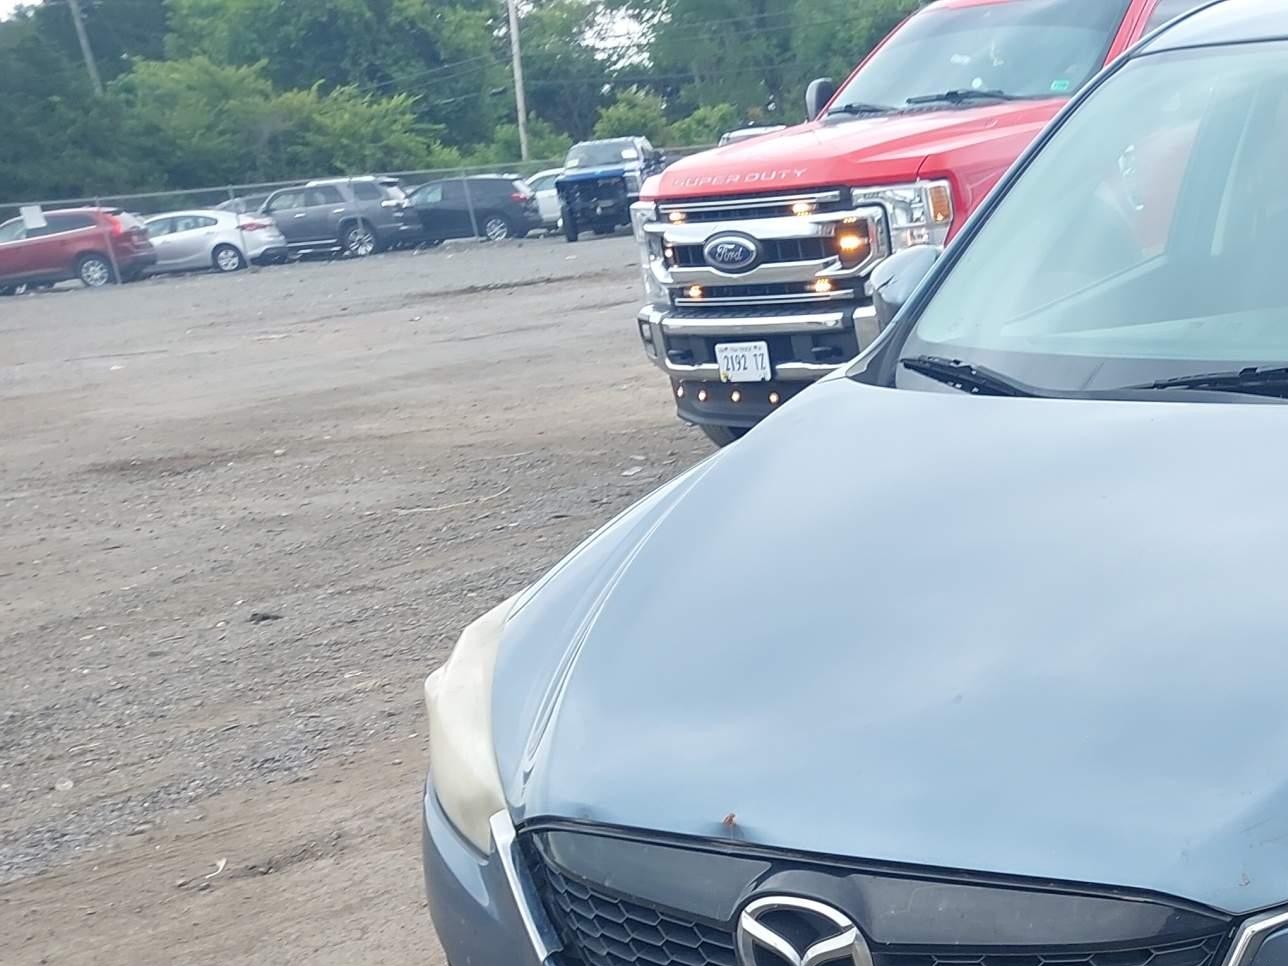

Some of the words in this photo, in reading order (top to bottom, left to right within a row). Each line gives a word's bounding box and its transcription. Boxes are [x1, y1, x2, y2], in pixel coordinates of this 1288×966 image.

[673, 175, 741, 188] SUPER
[744, 168, 808, 182] DUTY
[716, 243, 744, 260] Ford
[723, 354, 748, 371] 2192
